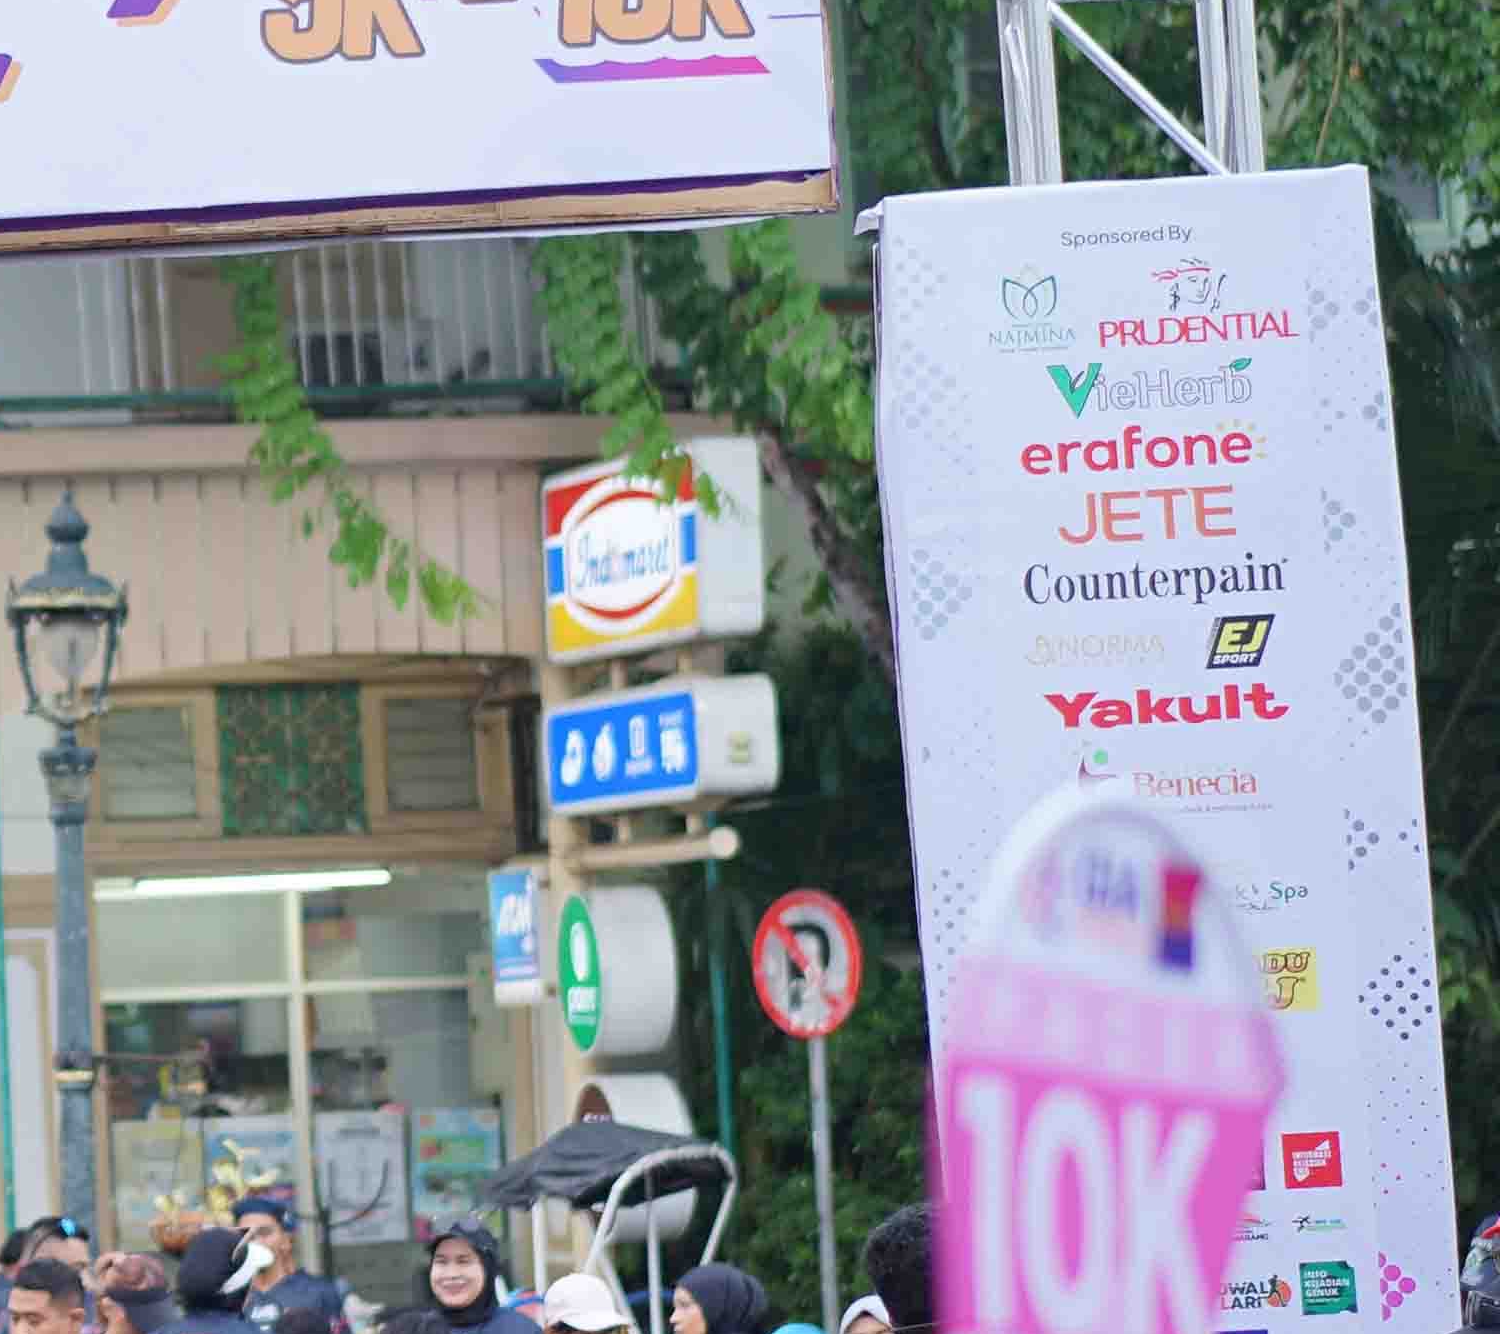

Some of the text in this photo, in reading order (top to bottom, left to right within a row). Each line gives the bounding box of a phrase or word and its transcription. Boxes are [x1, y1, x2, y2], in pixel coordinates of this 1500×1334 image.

[1060, 224, 1193, 250] Sponsored By
[1099, 311, 1300, 348] PRUDENTIAL
[1046, 359, 1253, 418] VieHerb
[1020, 425, 1253, 475] erafone
[1058, 485, 1237, 545] JETE
[572, 533, 669, 589] Indmaret
[1023, 552, 1285, 605] Counterpain
[1216, 620, 1269, 653] EJ
[1212, 652, 1257, 665] SPORT
[1044, 682, 1290, 728] Yakult
[1132, 769, 1258, 797] Benecia
[1269, 880, 1309, 904] Spa
